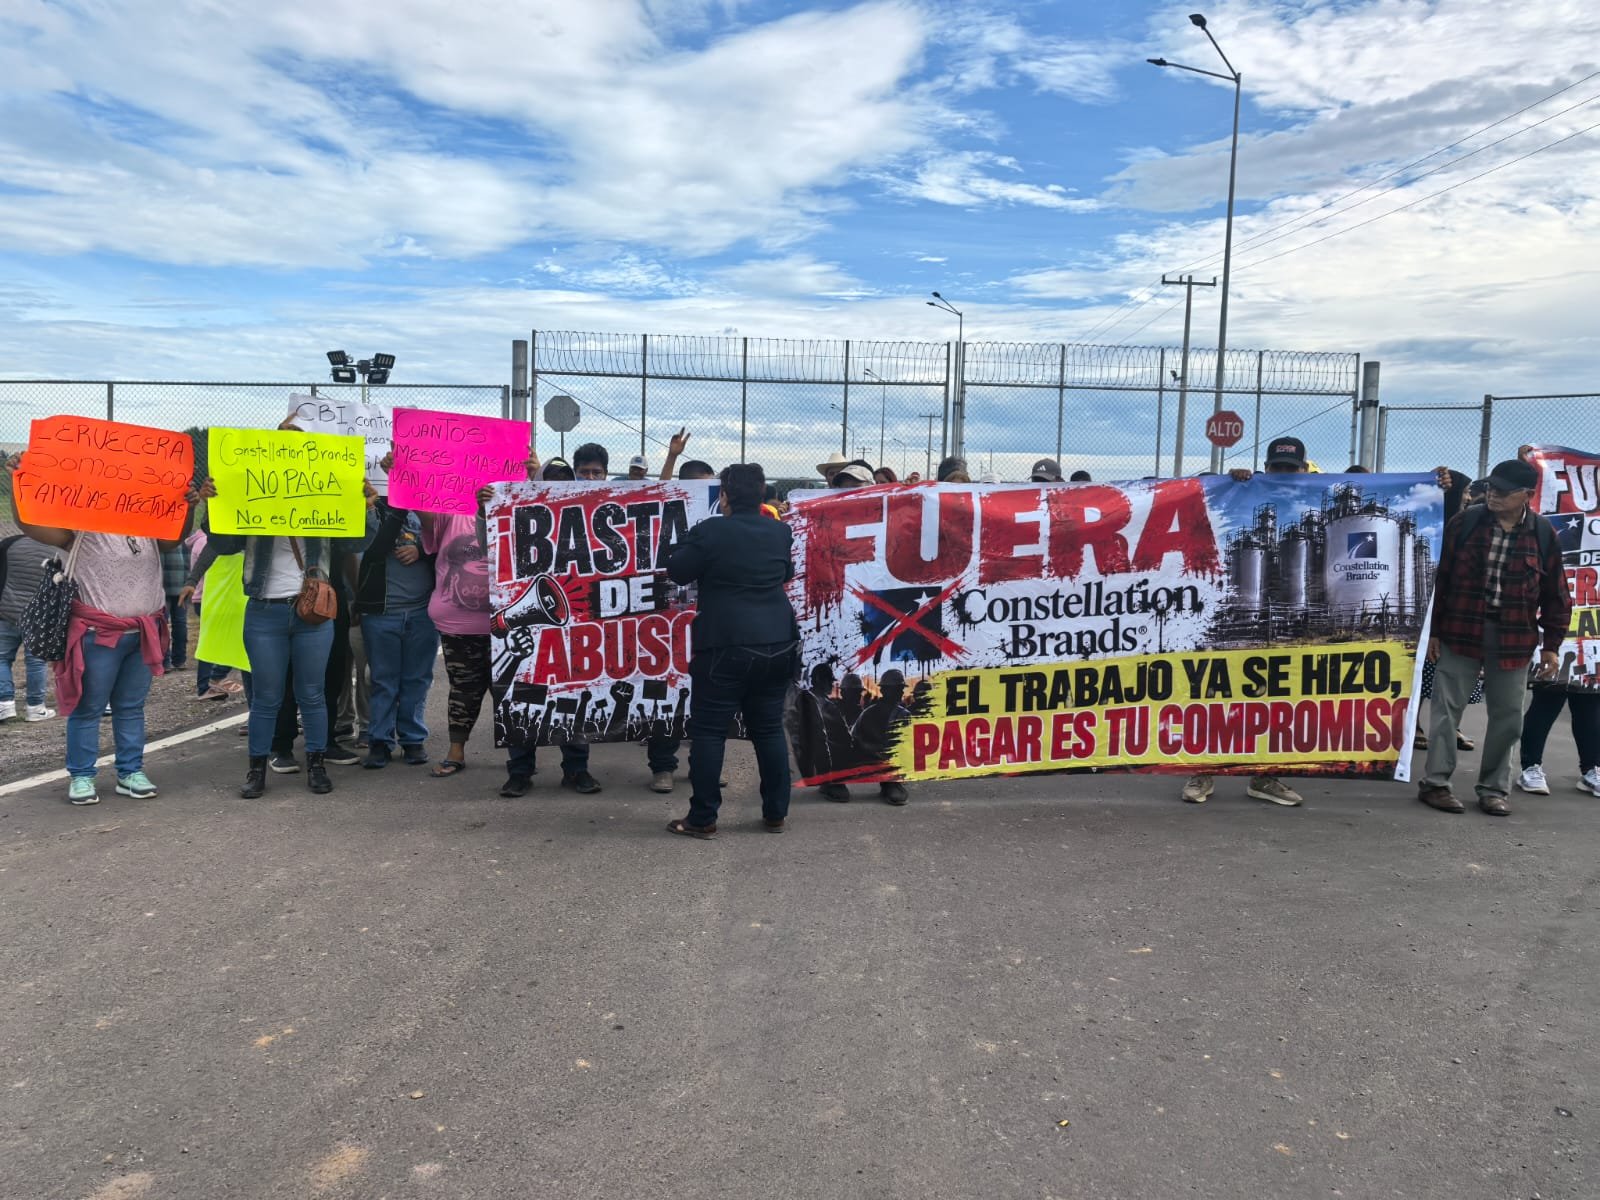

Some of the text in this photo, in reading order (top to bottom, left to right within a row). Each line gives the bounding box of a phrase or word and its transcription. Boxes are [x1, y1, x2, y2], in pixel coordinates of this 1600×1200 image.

[296, 402, 393, 428] CBI contr
[395, 411, 487, 443] CUANTOS
[1208, 421, 1242, 437] ALTO
[37, 423, 184, 465] ERVECERA
[393, 444, 454, 466] MESES
[464, 454, 499, 474] MAS
[139, 466, 187, 490] 300
[246, 468, 342, 496] NO PAGA
[392, 471, 420, 489] VAN
[424, 473, 436, 490] A
[236, 508, 346, 529] No es Confiable
[806, 479, 1221, 604] FUERA
[1333, 561, 1390, 573] Constellation
[600, 575, 655, 618] DE
[963, 579, 1200, 625] Constellation
[945, 650, 1402, 717] EL TRABAJO YA SE HIZO,
[912, 713, 1042, 772] PAGAR
[1051, 711, 1097, 761] ES
[1105, 705, 1150, 757] TU
